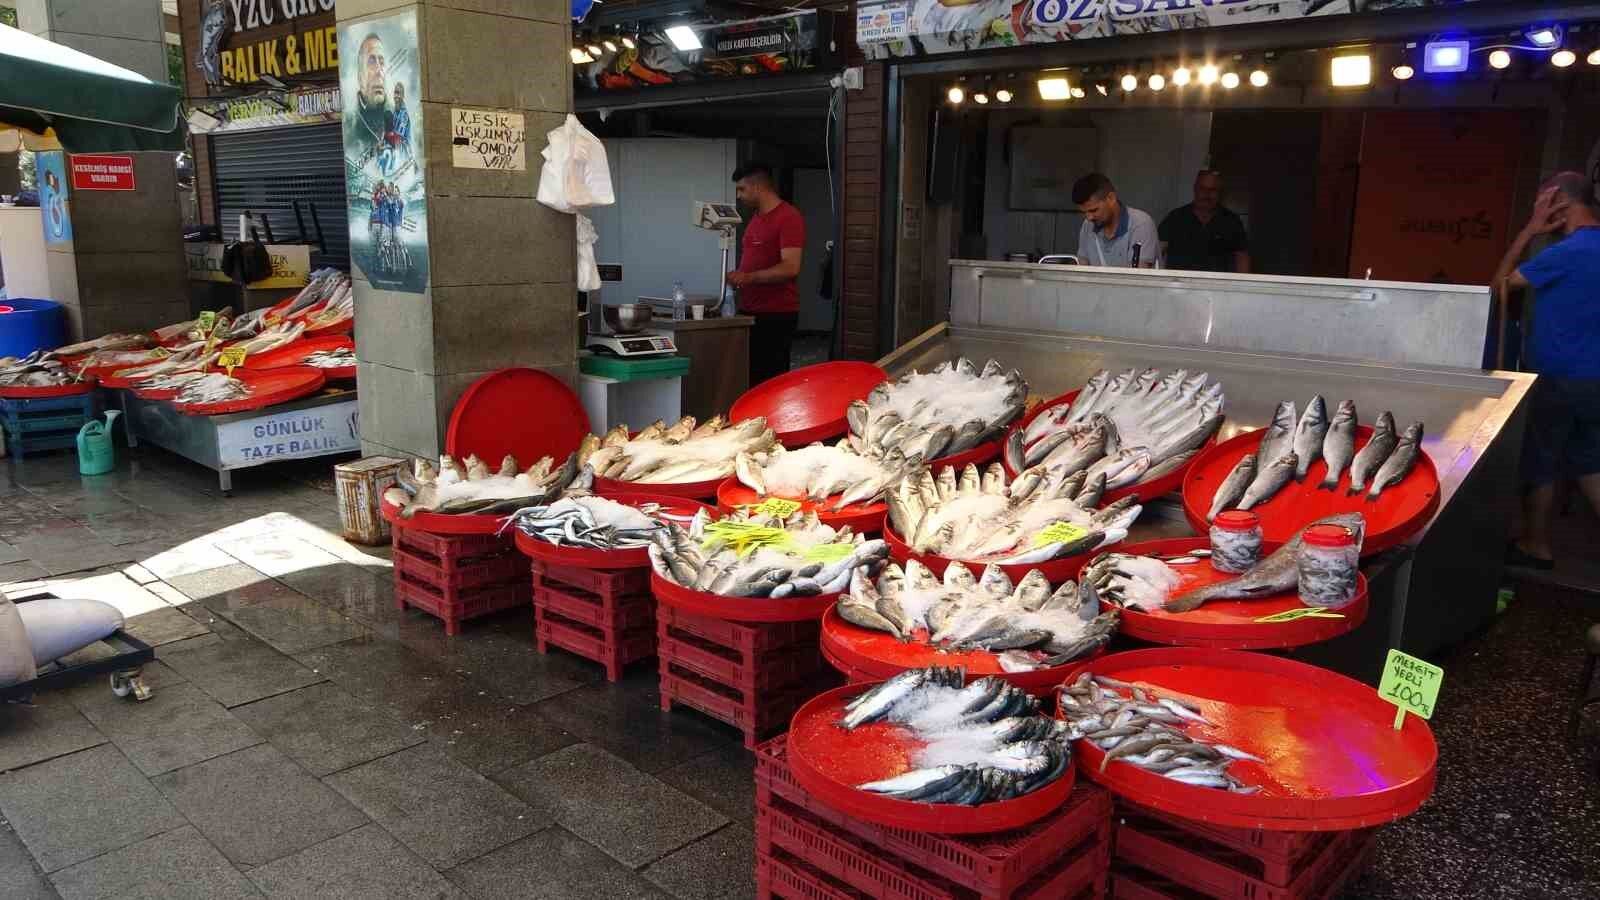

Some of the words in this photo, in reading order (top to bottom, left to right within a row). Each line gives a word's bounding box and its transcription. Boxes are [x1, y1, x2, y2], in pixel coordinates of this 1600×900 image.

[221, 39, 281, 83] BALIK
[285, 34, 301, 75] &
[254, 416, 325, 438] GÜNLÜK
[241, 443, 285, 459] TAZE
[290, 436, 338, 453] BALIK
